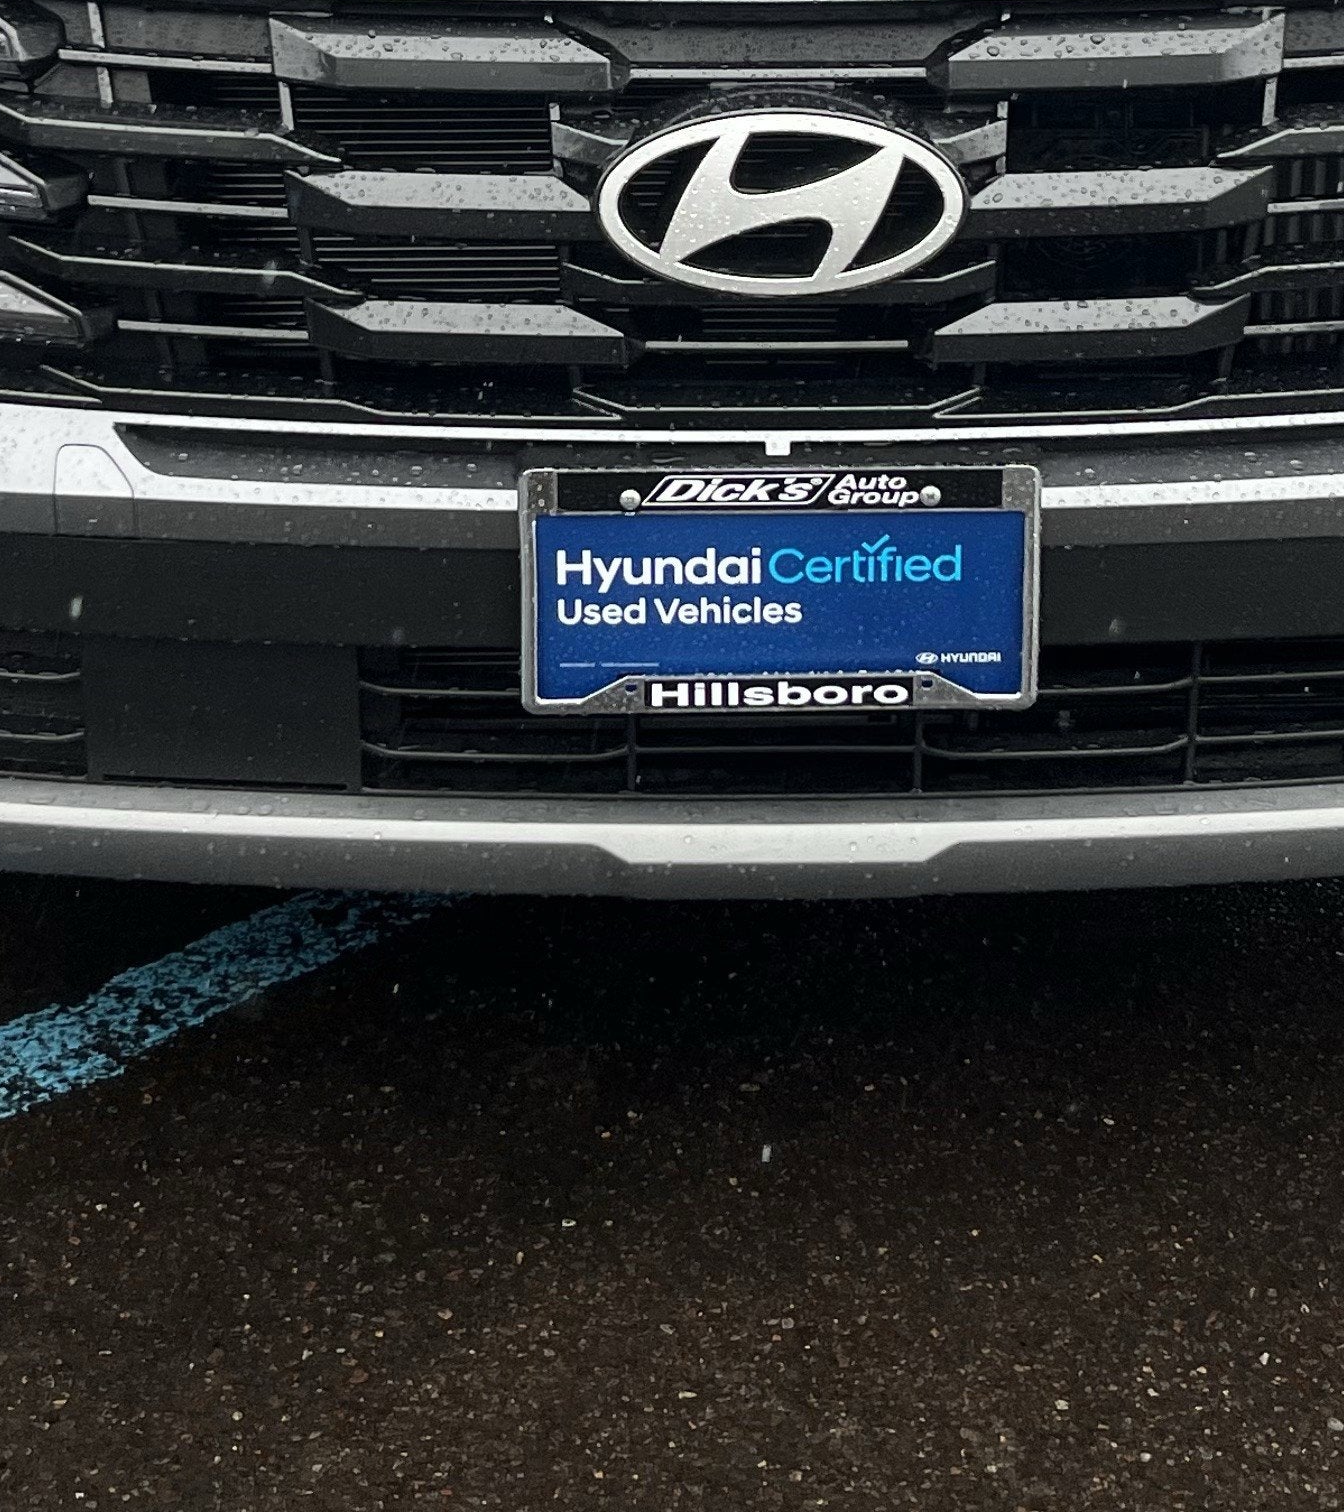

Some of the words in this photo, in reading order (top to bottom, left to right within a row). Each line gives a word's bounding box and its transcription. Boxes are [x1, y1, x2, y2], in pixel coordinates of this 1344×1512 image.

[835, 474, 907, 490] Auto
[828, 489, 921, 507] Group
[556, 547, 762, 594] Hyundai
[768, 534, 963, 585] Certified
[556, 597, 647, 626] Used
[653, 596, 804, 625] Vehicles
[940, 651, 1002, 663] HYUNDAI
[650, 680, 910, 707] Hillsboro
